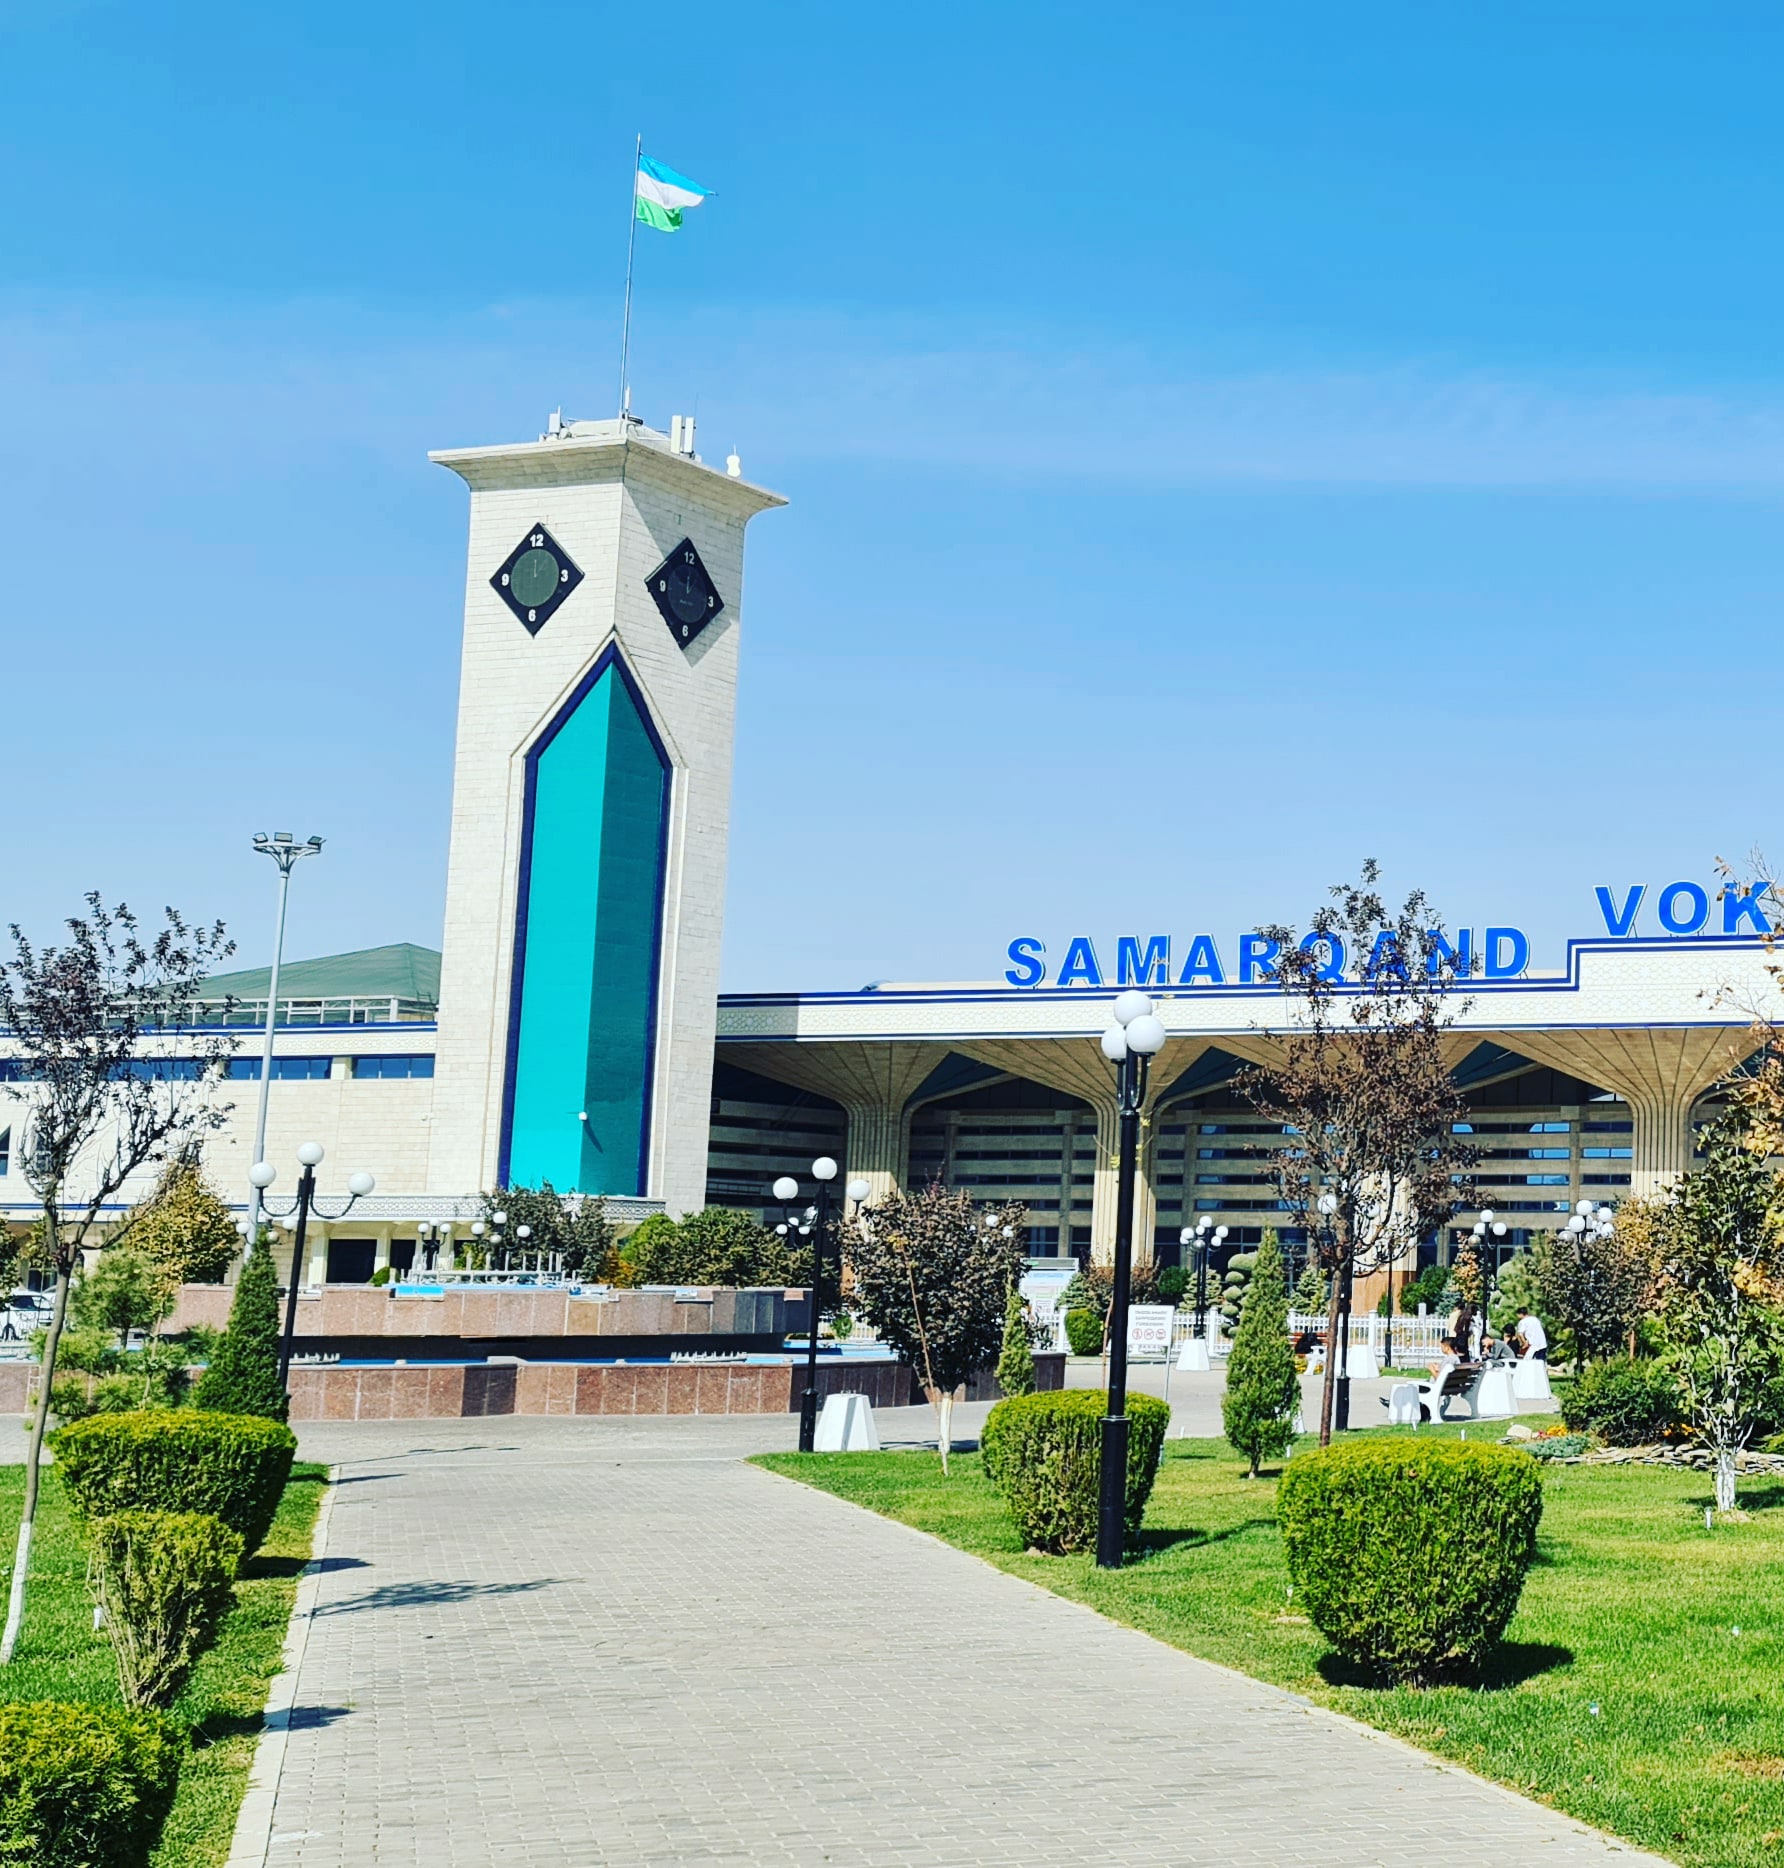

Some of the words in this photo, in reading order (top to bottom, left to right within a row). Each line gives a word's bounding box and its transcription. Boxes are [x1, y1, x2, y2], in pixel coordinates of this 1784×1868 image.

[529, 534, 544, 548] 12
[683, 551, 695, 565] 12
[501, 573, 510, 586] 9
[560, 569, 569, 582] 3
[707, 595, 714, 608] 3
[528, 609, 536, 622] 6
[682, 624, 689, 637] 6
[1004, 926, 1530, 988] SAMARQAND
